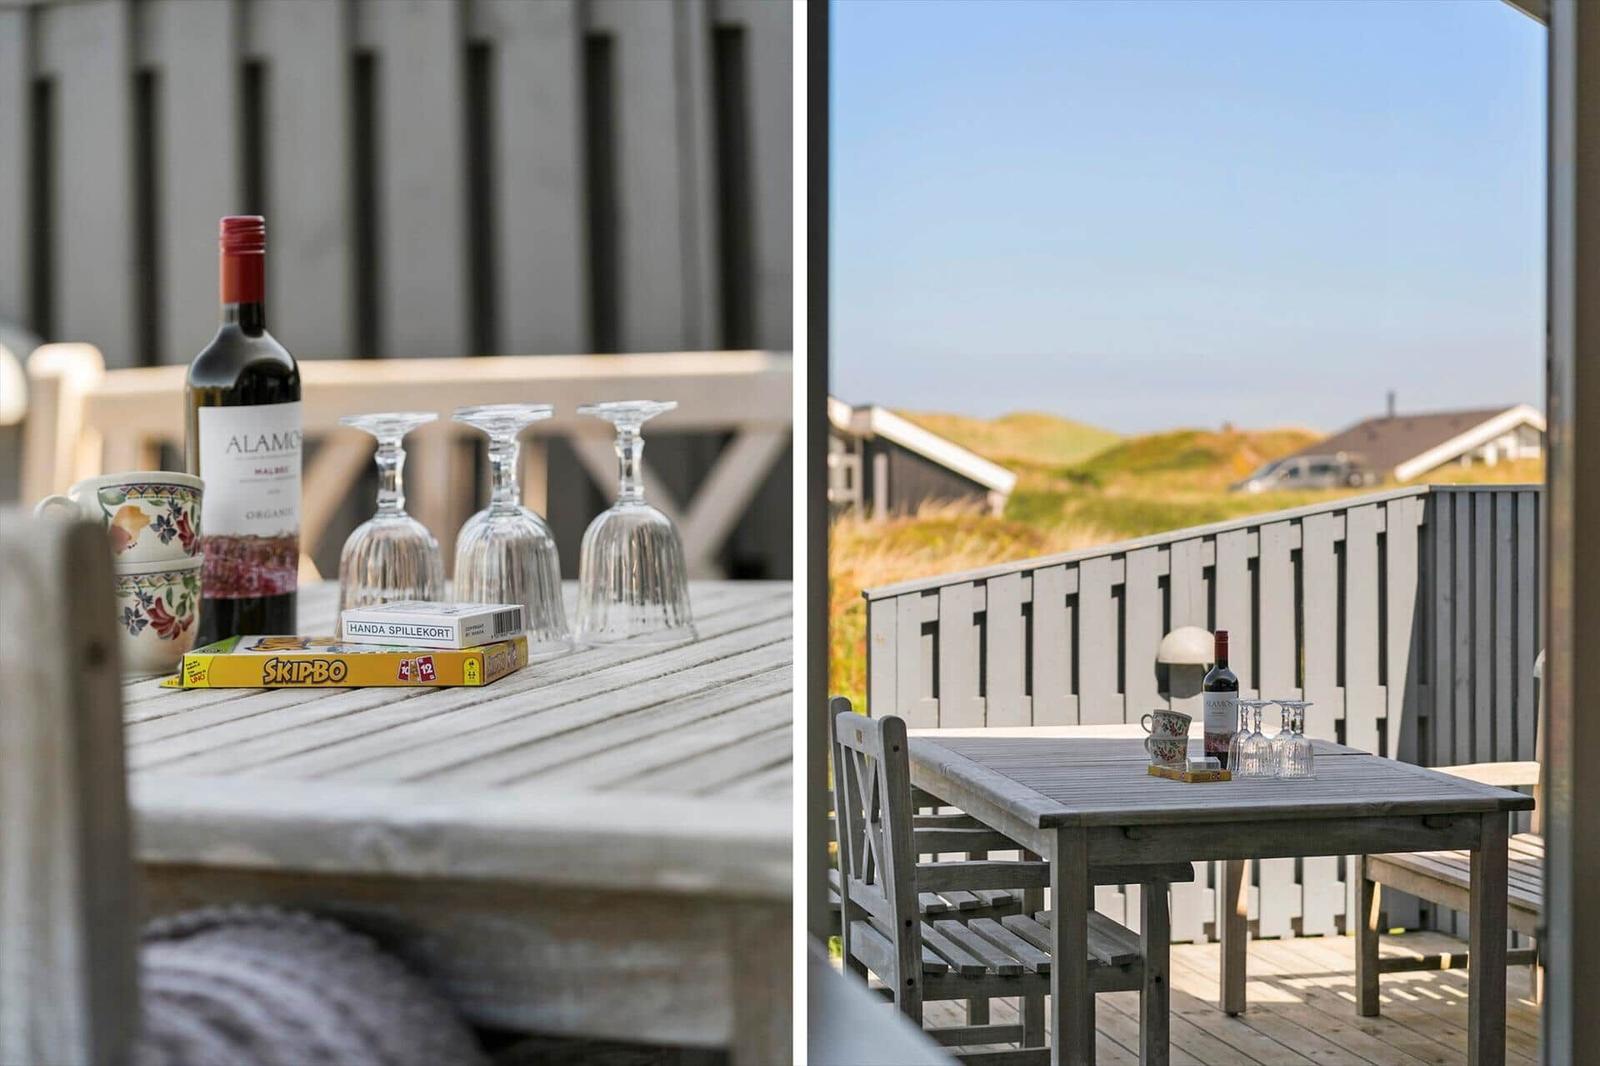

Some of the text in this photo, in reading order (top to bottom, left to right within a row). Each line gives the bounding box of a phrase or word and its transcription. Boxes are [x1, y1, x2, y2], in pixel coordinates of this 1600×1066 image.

[349, 624, 451, 639] HANDA SPILLEKORT
[421, 664, 433, 674] 12
